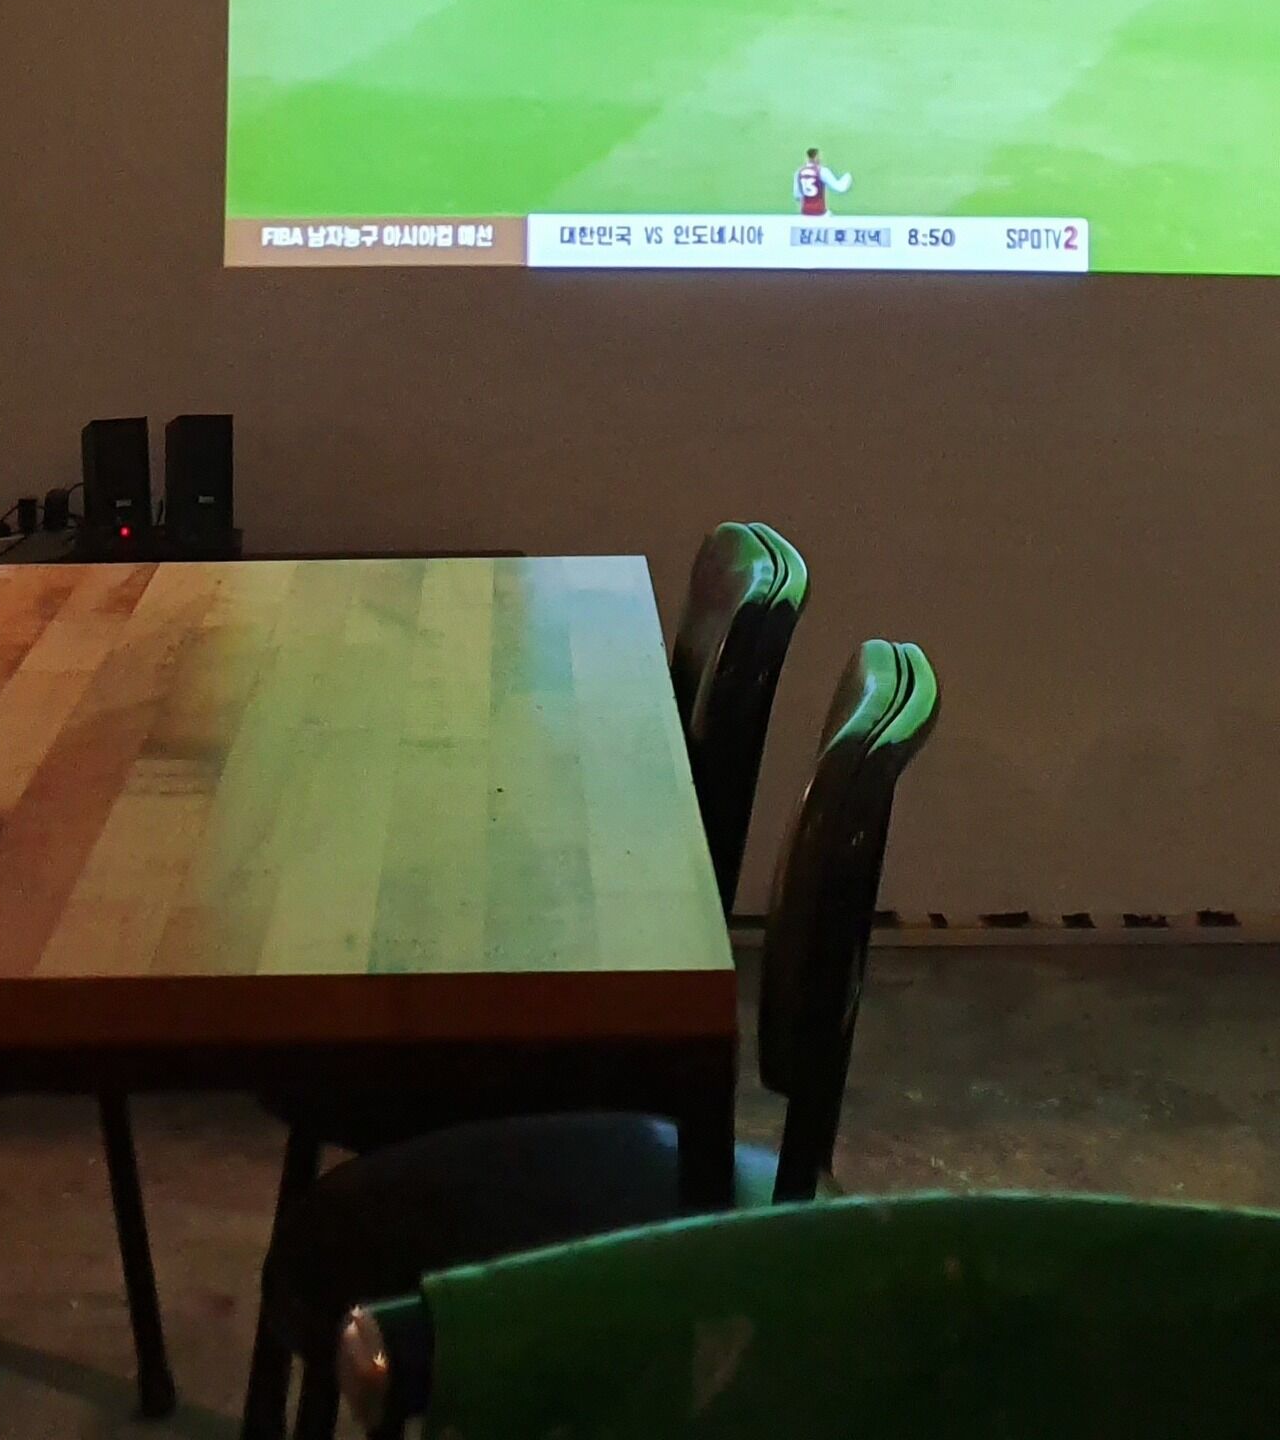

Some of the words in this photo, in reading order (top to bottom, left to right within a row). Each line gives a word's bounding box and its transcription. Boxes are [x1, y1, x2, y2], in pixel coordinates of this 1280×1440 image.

[261, 226, 305, 247] FIBA
[559, 225, 632, 246] 대한민국
[644, 226, 664, 245] VS
[673, 225, 765, 246] 인도네시아
[907, 228, 956, 247] 8:50
